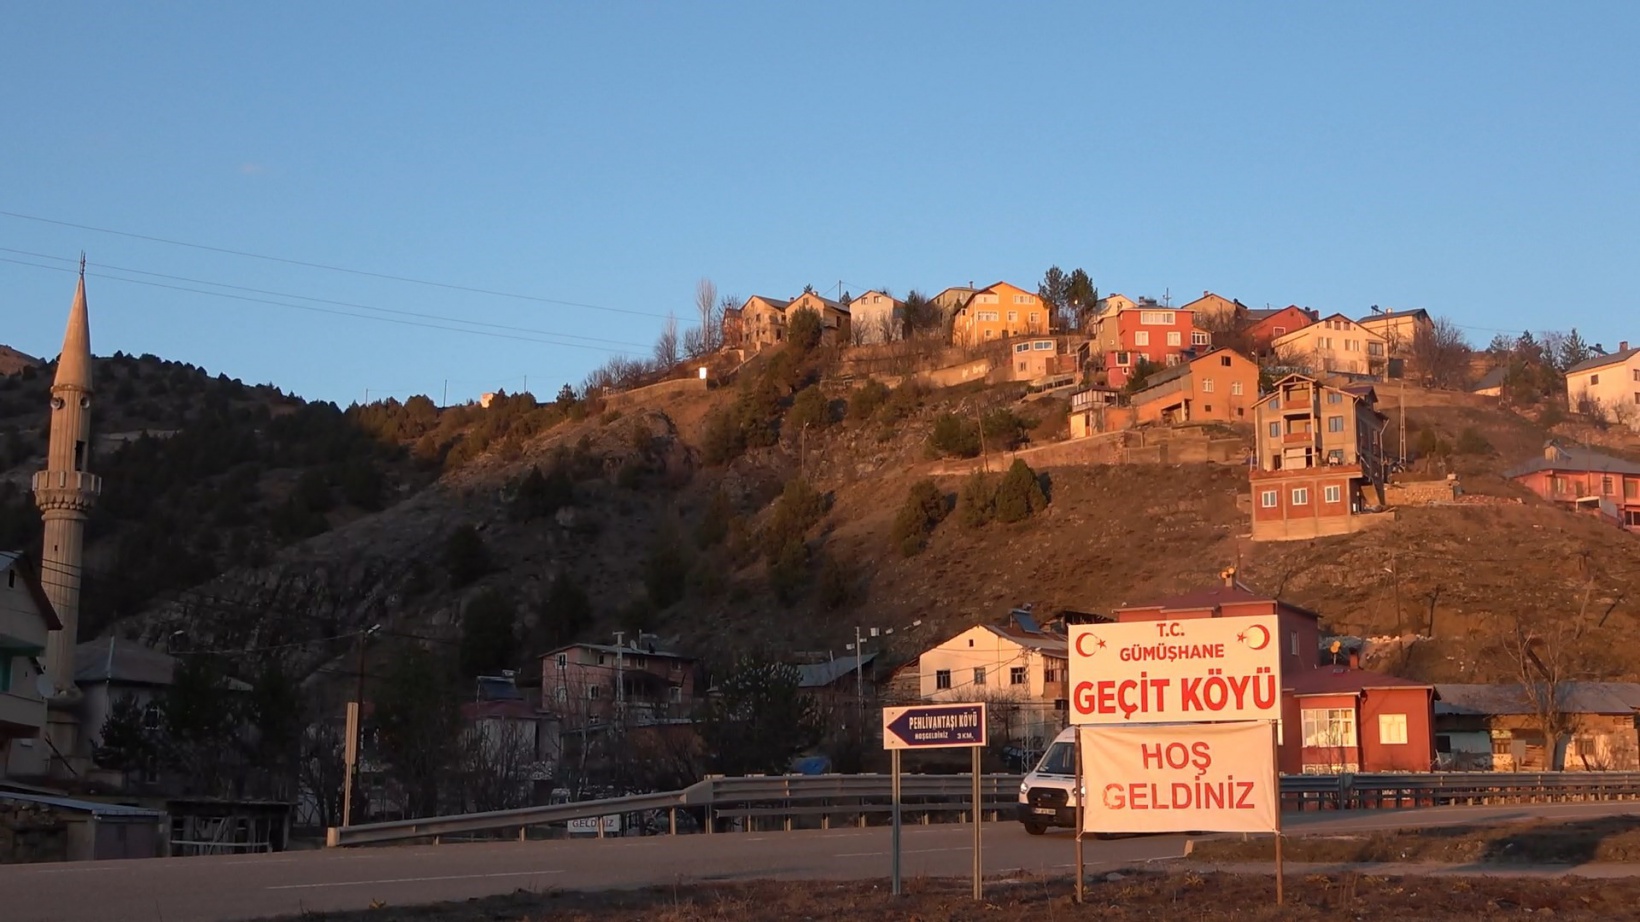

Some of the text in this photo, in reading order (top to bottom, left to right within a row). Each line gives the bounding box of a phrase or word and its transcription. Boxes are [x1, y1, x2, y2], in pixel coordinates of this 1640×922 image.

[1156, 622, 1185, 637] T.C.
[1120, 643, 1224, 662] GÜMÜŞHANE
[1074, 667, 1276, 720] GEÇİT KÖYÜ
[909, 712, 977, 731] PEHLİVANTAŞI KÖYÜ
[1142, 742, 1211, 776] HOŞ
[1103, 775, 1255, 810] GELDİNİZ
